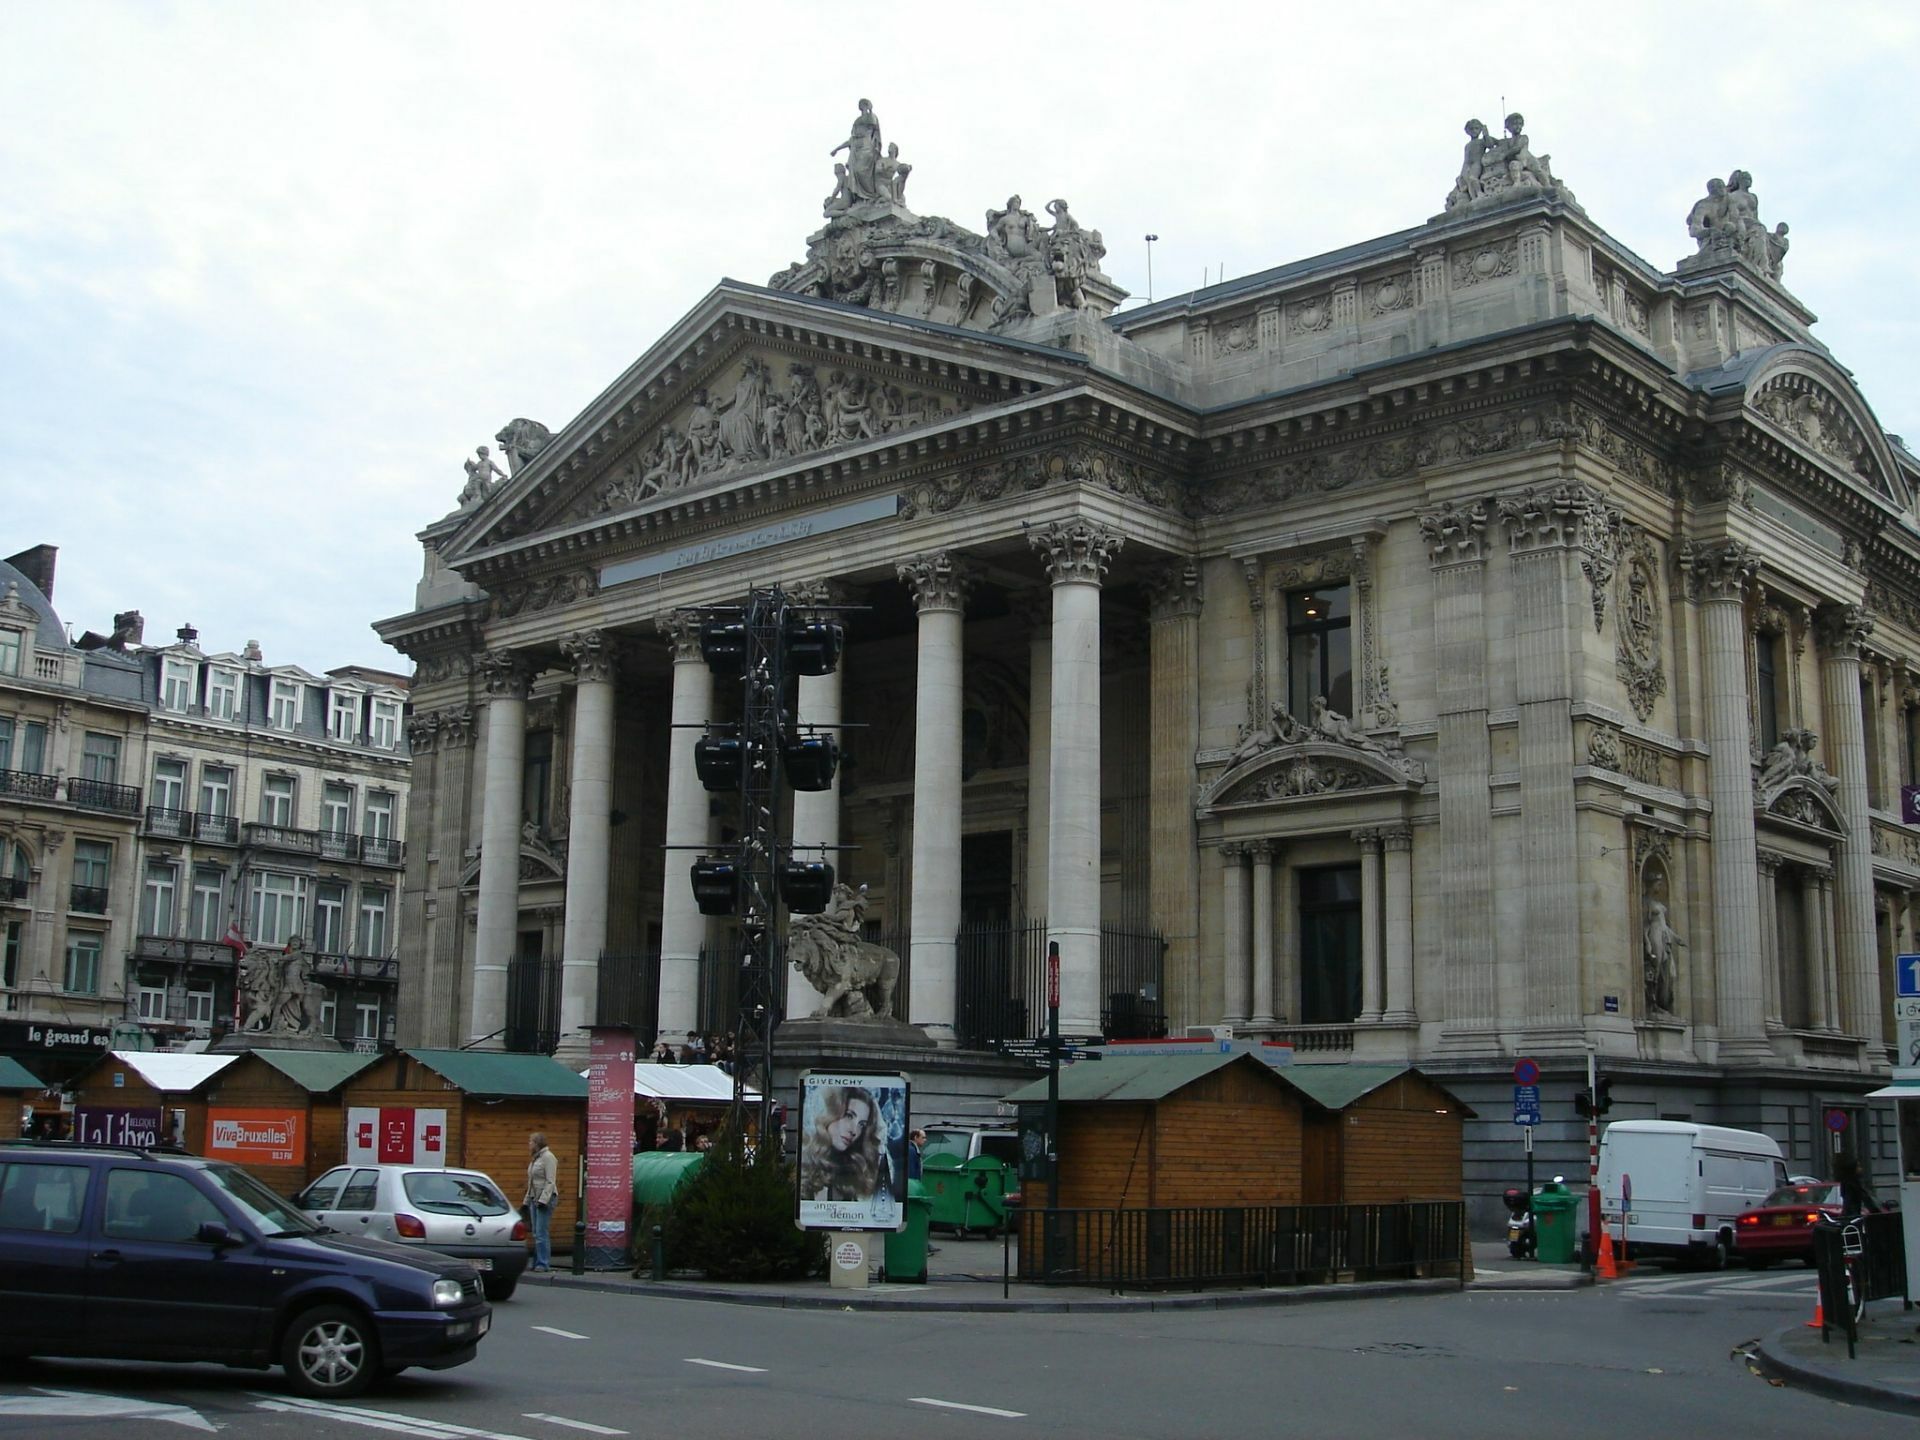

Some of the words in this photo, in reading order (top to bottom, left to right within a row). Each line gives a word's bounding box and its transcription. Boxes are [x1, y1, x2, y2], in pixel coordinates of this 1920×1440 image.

[28, 1026, 41, 1041] le
[44, 1028, 90, 1047] grand
[808, 1078, 863, 1086] GIVENCHY
[106, 1112, 156, 1147] Libre
[215, 1126, 287, 1144] VivaBruxelles
[814, 1203, 837, 1211] ange
